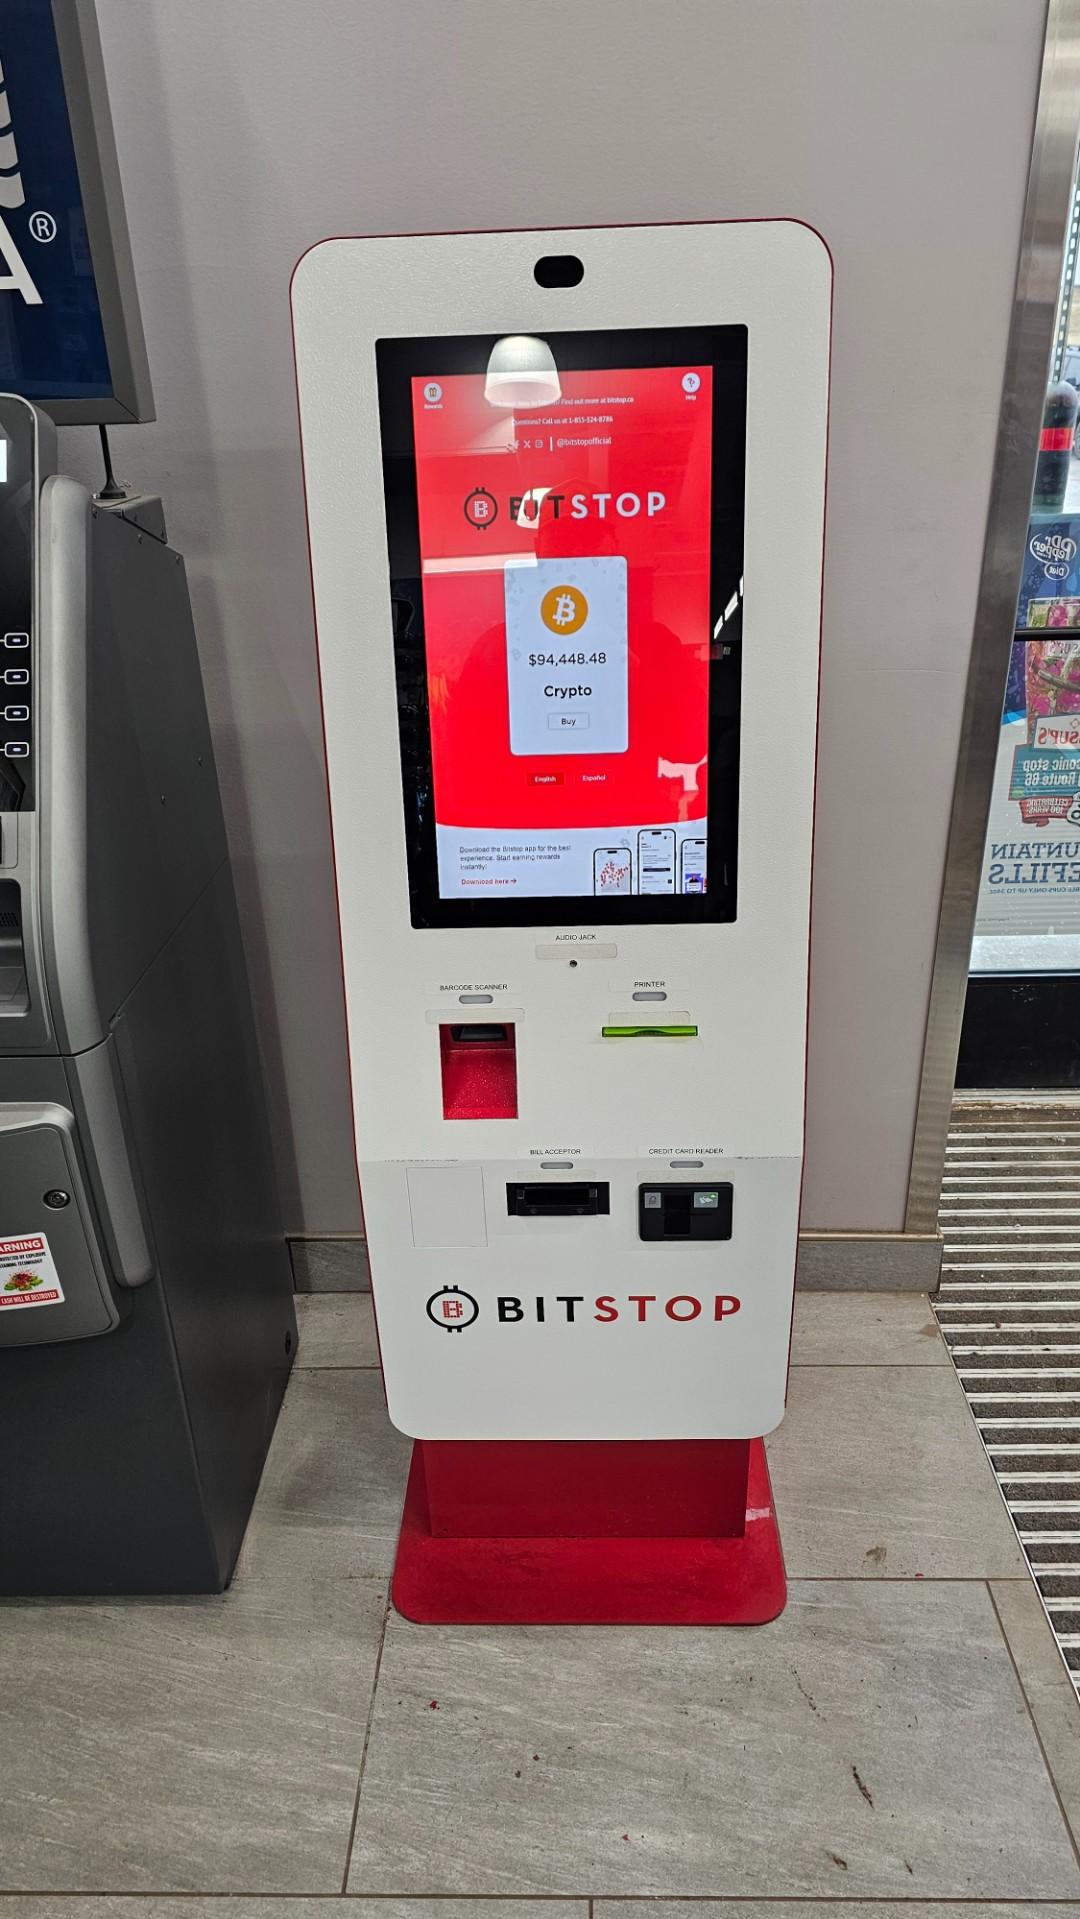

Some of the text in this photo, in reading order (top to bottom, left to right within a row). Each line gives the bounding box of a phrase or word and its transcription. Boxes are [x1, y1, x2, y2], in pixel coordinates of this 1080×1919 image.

[557, 436, 612, 448] @bitstopofficial
[509, 492, 666, 520] BTSTOP
[528, 652, 607, 668] $94,448.48
[544, 684, 592, 699] Crypto
[561, 717, 576, 728] Buy
[534, 775, 556, 783] English
[582, 774, 606, 782] Español
[496, 1295, 742, 1322] BITSTOP
